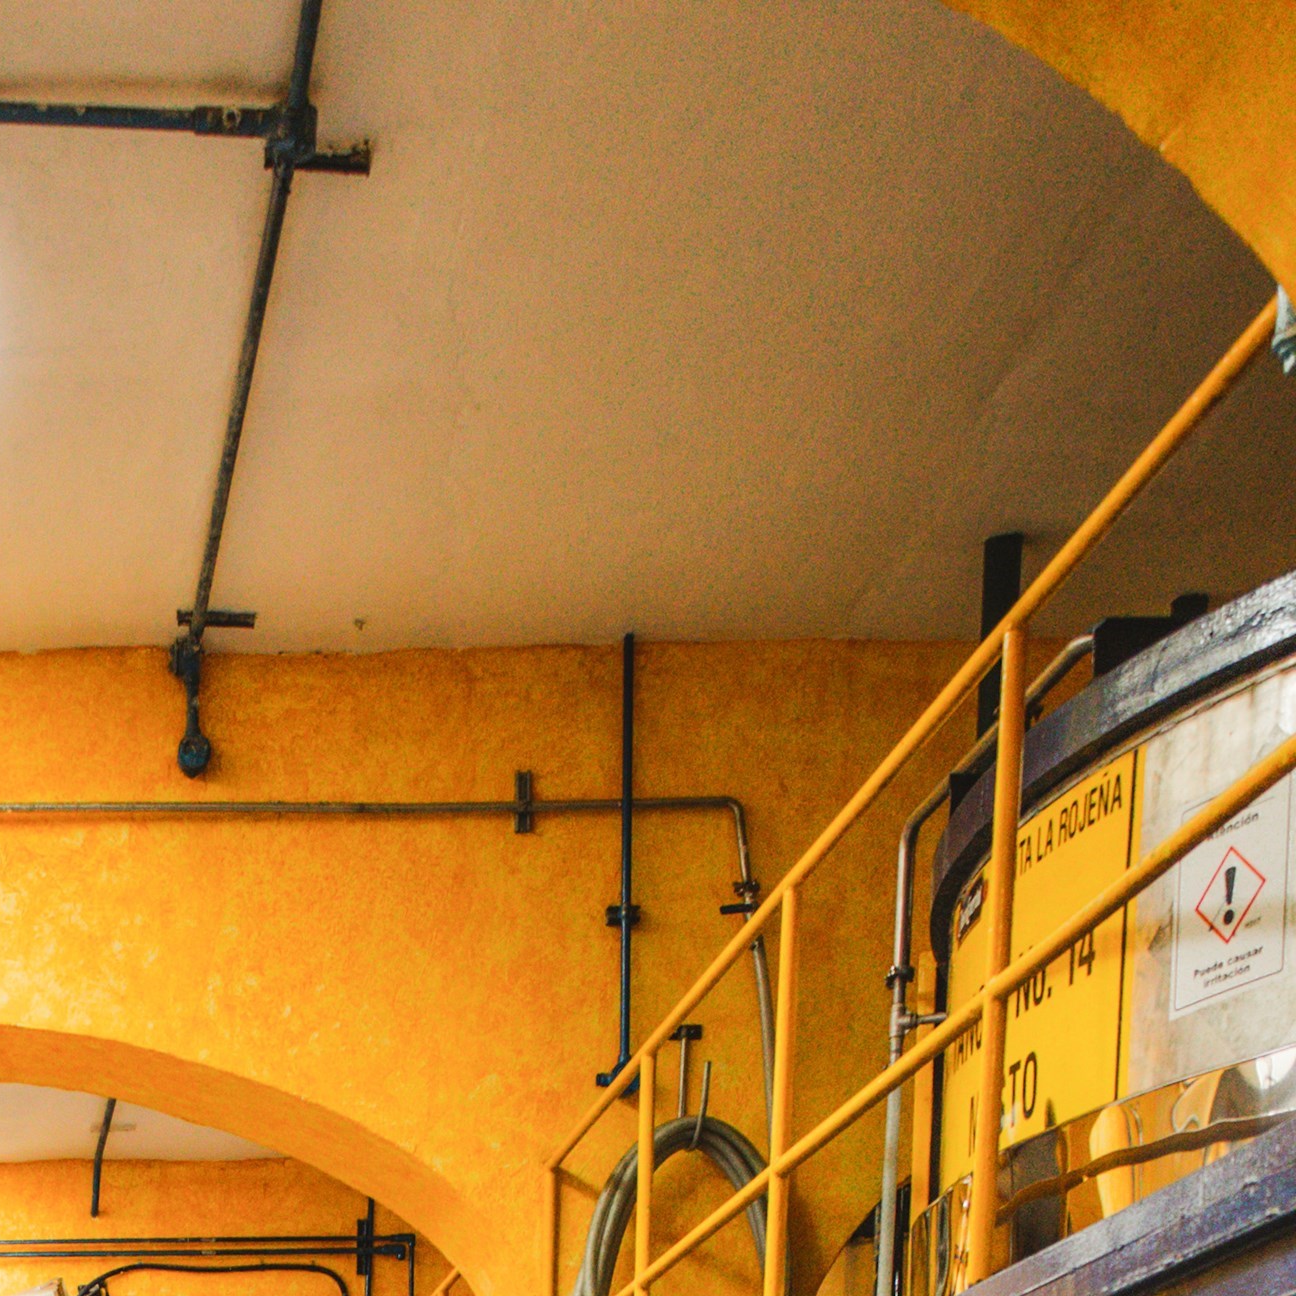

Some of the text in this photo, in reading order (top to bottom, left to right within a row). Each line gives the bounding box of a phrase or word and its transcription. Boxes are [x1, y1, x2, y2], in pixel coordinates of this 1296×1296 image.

[1036, 818, 1054, 863] LA
[1057, 771, 1123, 848] ROJEÑA
[1193, 946, 1264, 978] Puede causar
